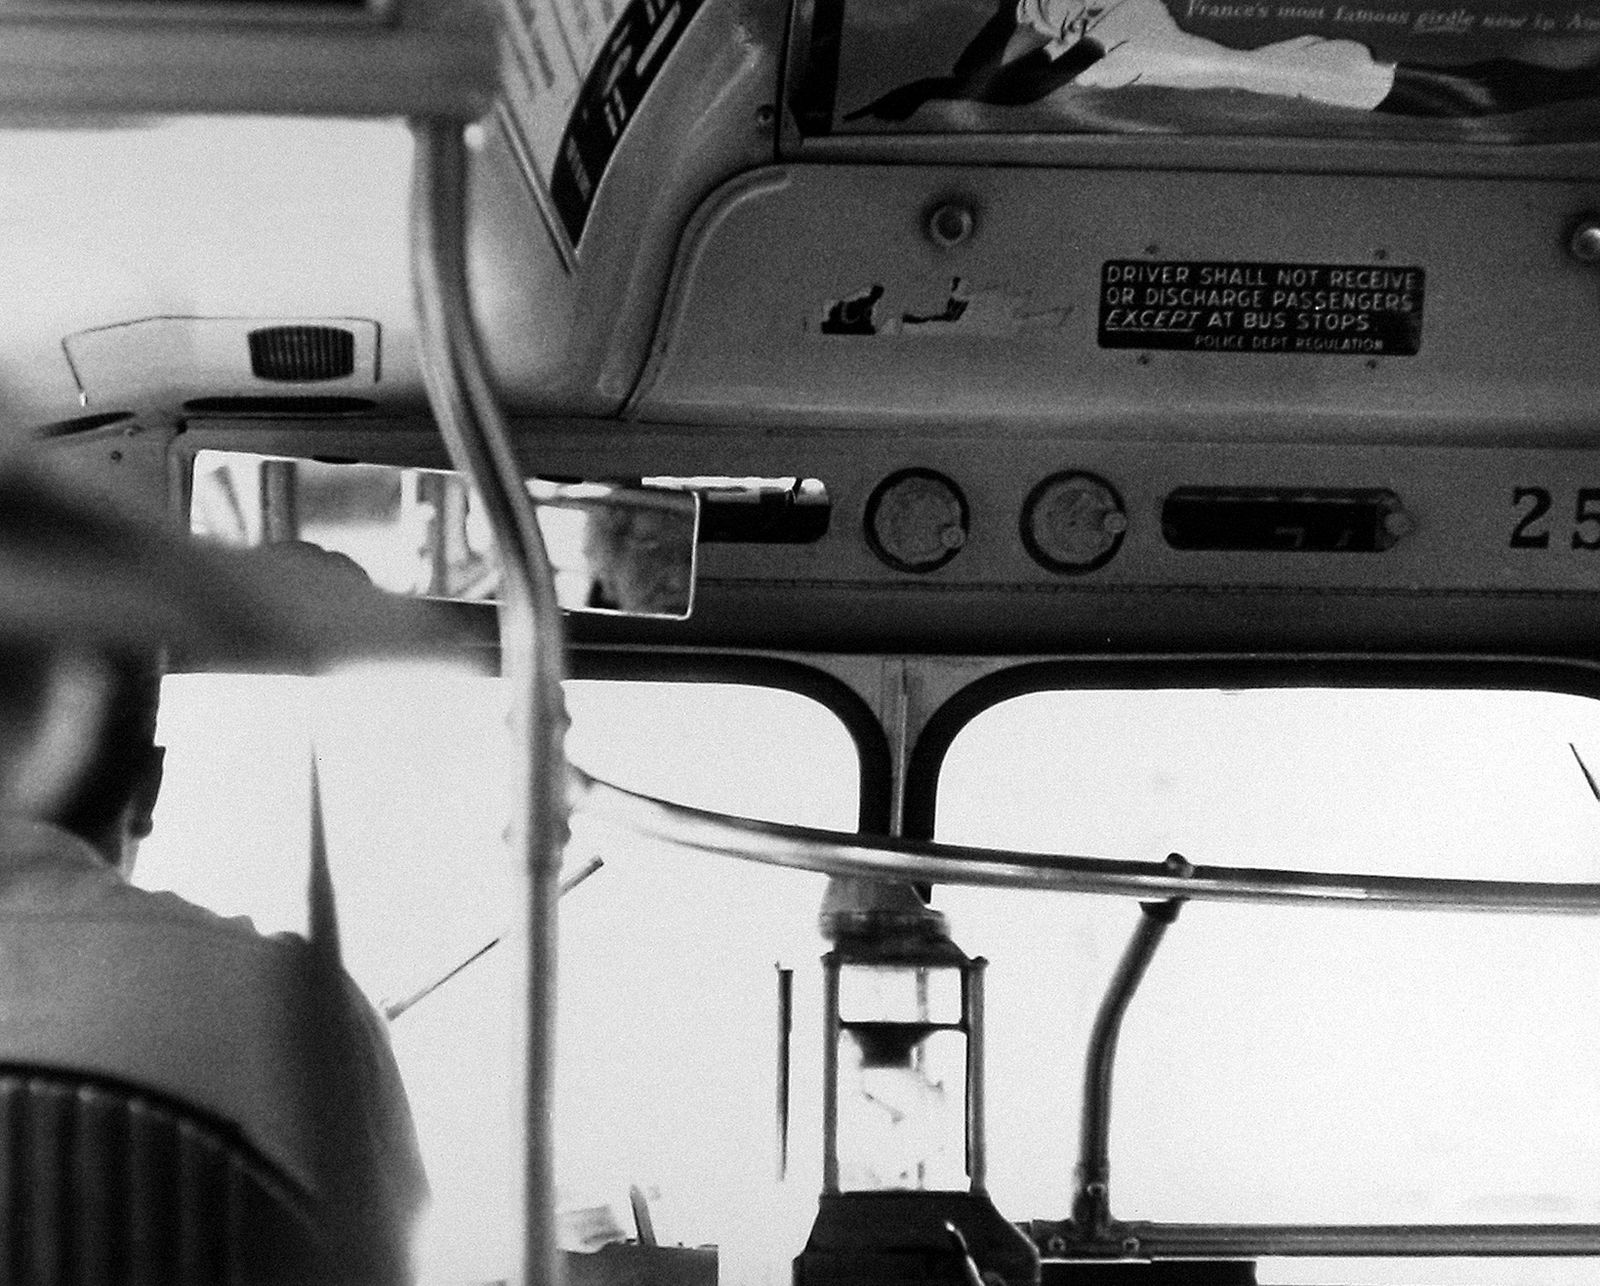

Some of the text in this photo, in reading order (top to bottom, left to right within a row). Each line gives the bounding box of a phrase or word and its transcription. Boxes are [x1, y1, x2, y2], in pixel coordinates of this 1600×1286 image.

[1333, 5, 1410, 25] famous
[1106, 265, 1416, 290] DRIVER SHALL NOT RECEIVE
[1106, 287, 1414, 312] OR DISCHARGE PASSENGERS
[1105, 309, 1201, 329] EXCEPT
[1207, 312, 1234, 328] AT
[1243, 312, 1287, 328] BUS
[1195, 335, 1245, 348] POLICE
[1252, 336, 1288, 349] DEPT
[1509, 486, 1600, 550] 25
